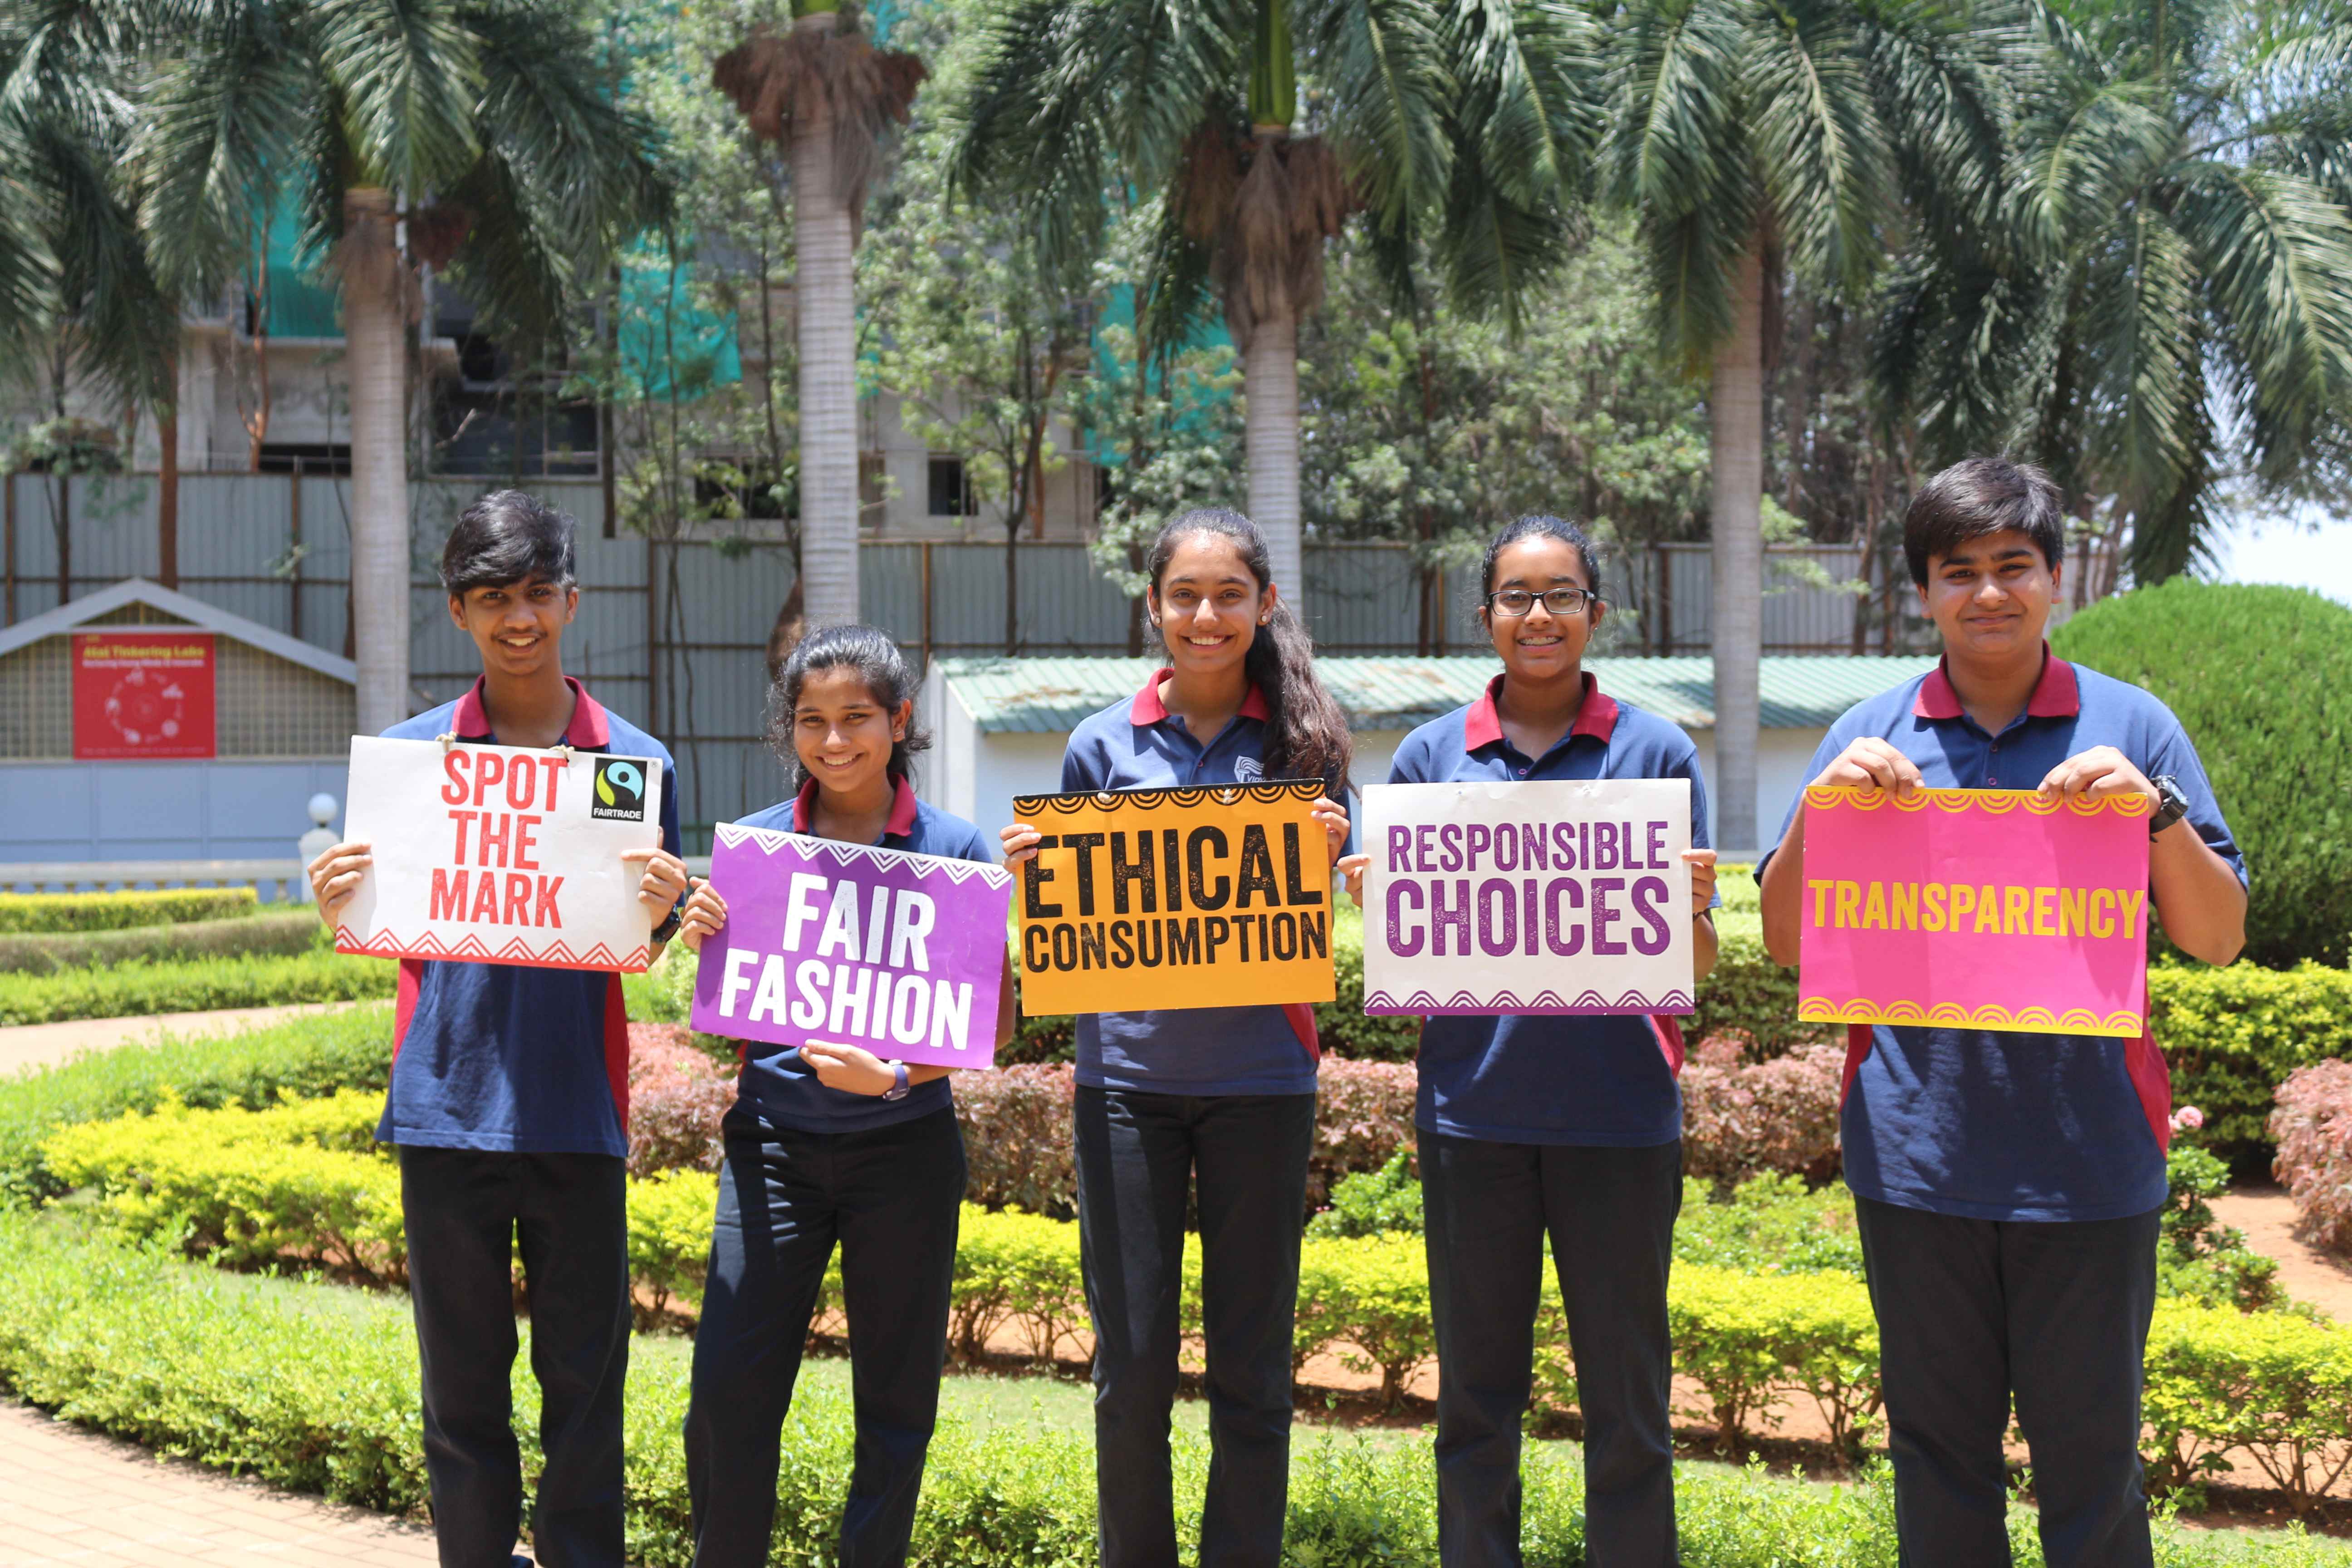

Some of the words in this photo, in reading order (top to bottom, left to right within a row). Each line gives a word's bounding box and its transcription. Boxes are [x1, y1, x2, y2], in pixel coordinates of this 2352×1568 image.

[441, 749, 568, 812] SPOT
[448, 809, 542, 870] THE
[593, 808, 642, 819] FAIRTRADE
[1024, 822, 1323, 919] ETHICAL
[1388, 821, 1669, 872] RESPONSIBLE
[429, 868, 565, 929] MARK
[782, 872, 936, 972] FAIR
[1386, 876, 1671, 957] CHOICES
[1808, 879, 2145, 939] TRANSPARENCY
[1024, 911, 1327, 973] CONSUMPTION
[718, 948, 973, 1051] FASHION
